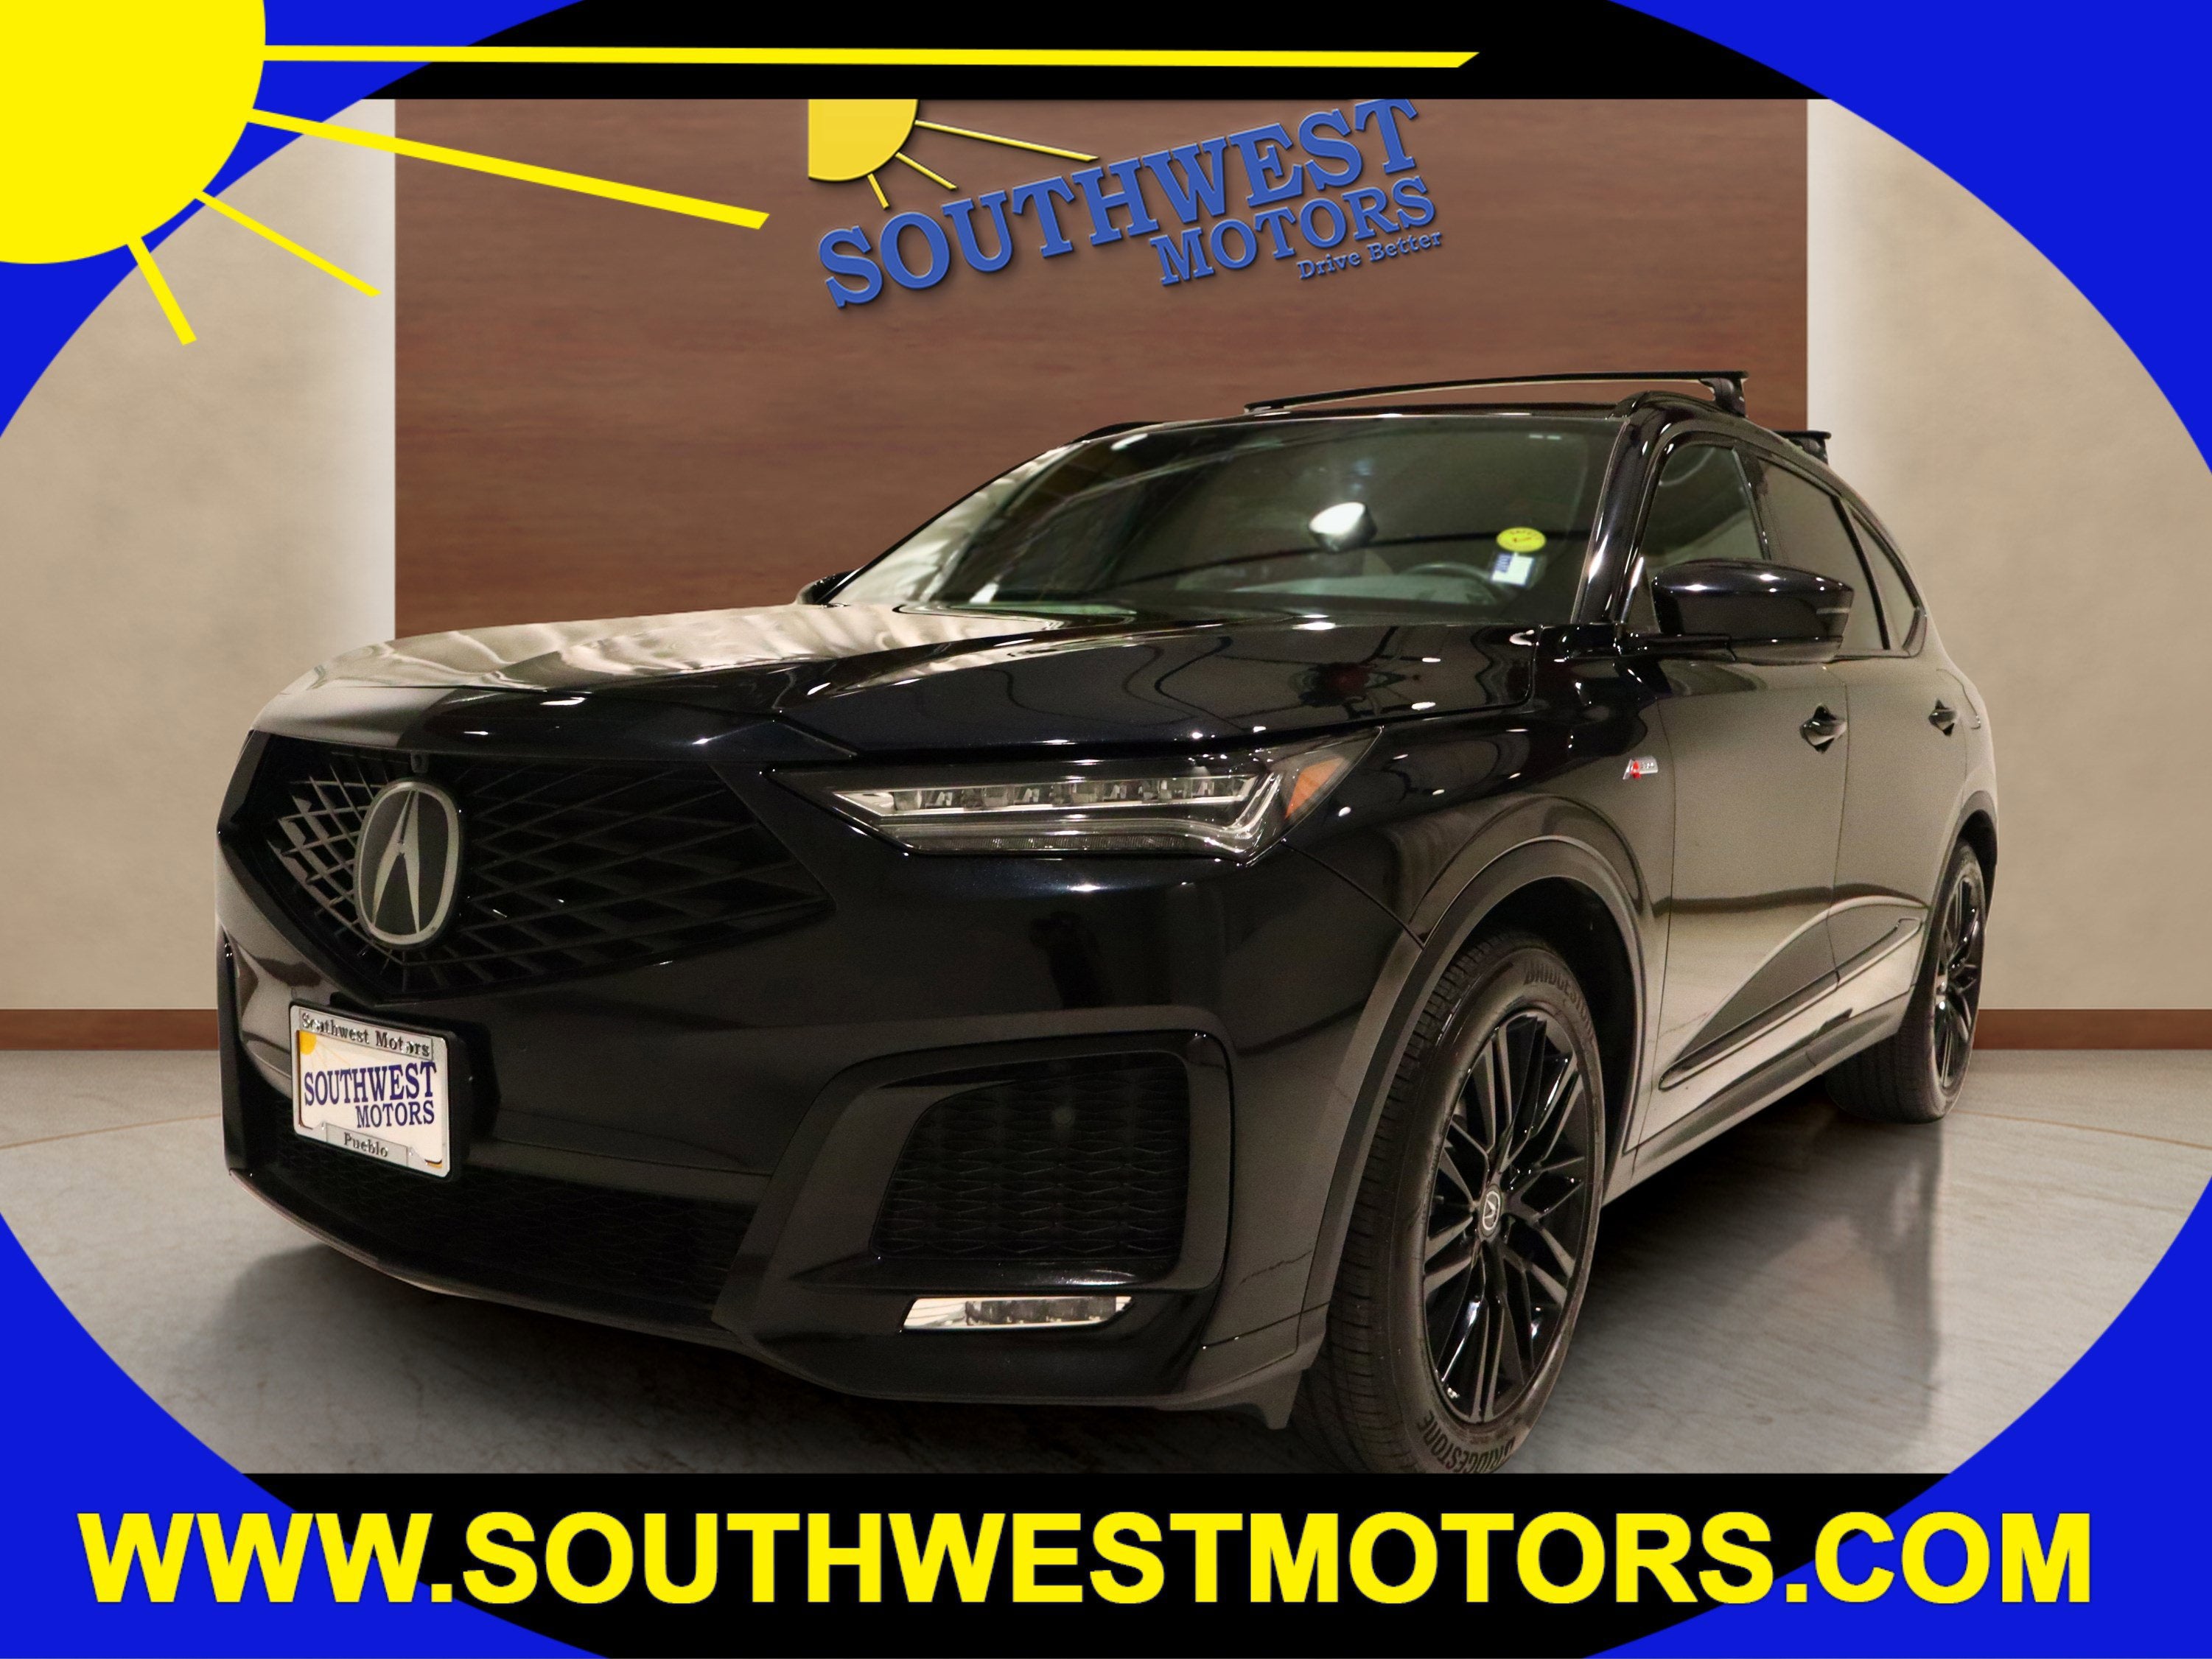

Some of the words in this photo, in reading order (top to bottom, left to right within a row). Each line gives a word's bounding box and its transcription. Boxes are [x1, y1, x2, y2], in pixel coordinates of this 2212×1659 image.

[819, 99, 1417, 308] SOUTHWEST
[1150, 176, 1435, 286] MOTORS
[1298, 249, 1361, 280] Drive
[1368, 231, 1442, 263] Better
[302, 1012, 369, 1045] Southwest
[375, 1030, 430, 1057] Motors
[304, 1061, 437, 1106] SOUTHWEST
[355, 1100, 435, 1128] MOTORS
[343, 1132, 388, 1157] Pueblo
